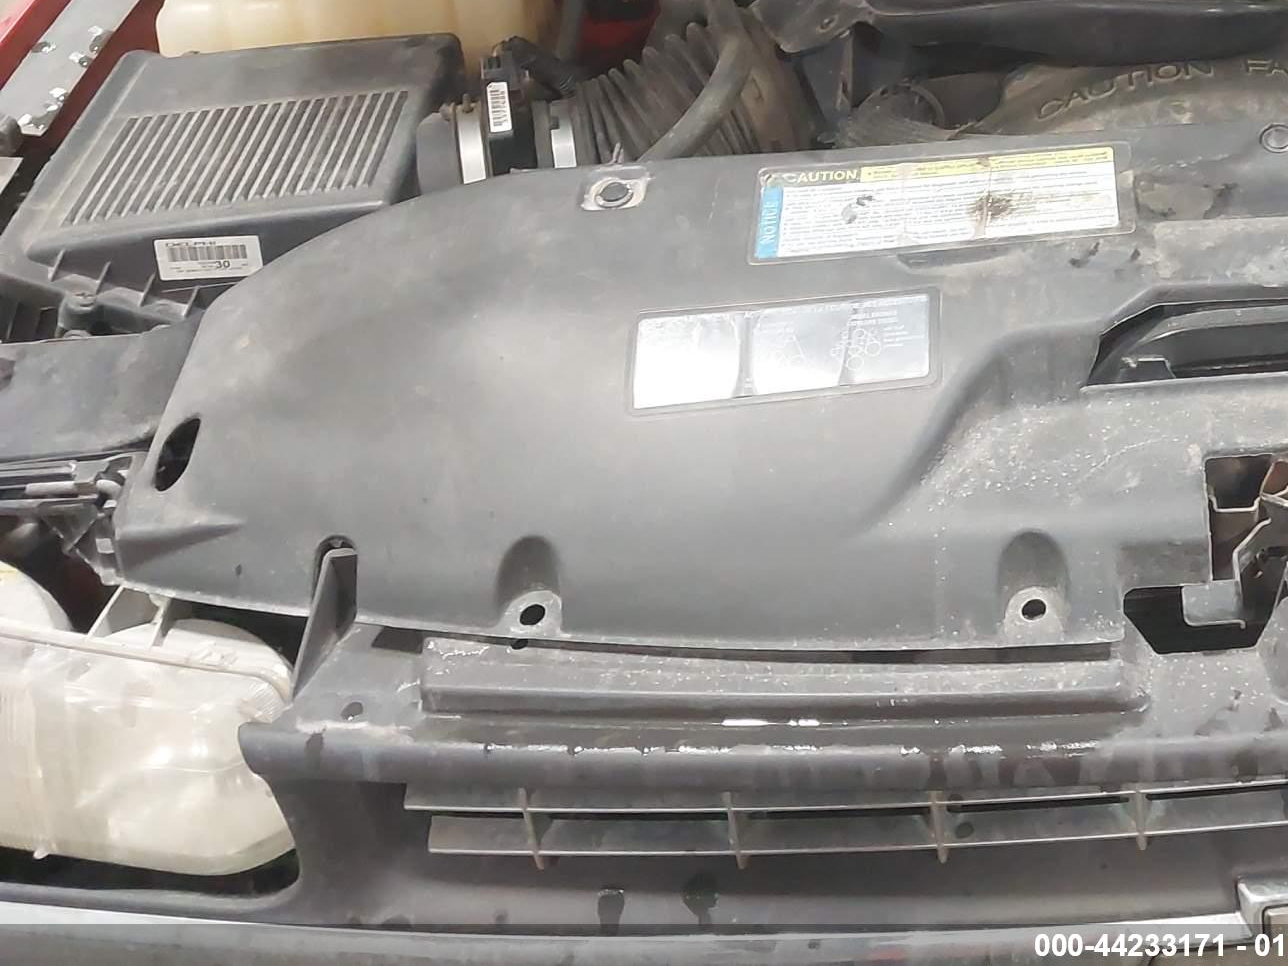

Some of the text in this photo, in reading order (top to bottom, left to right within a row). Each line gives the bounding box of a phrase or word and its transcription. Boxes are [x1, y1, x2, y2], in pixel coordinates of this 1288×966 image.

[1035, 61, 1215, 121] CAUTION
[782, 169, 858, 183] CAUTION
[760, 201, 778, 244] NOTICE
[216, 260, 231, 270] 30
